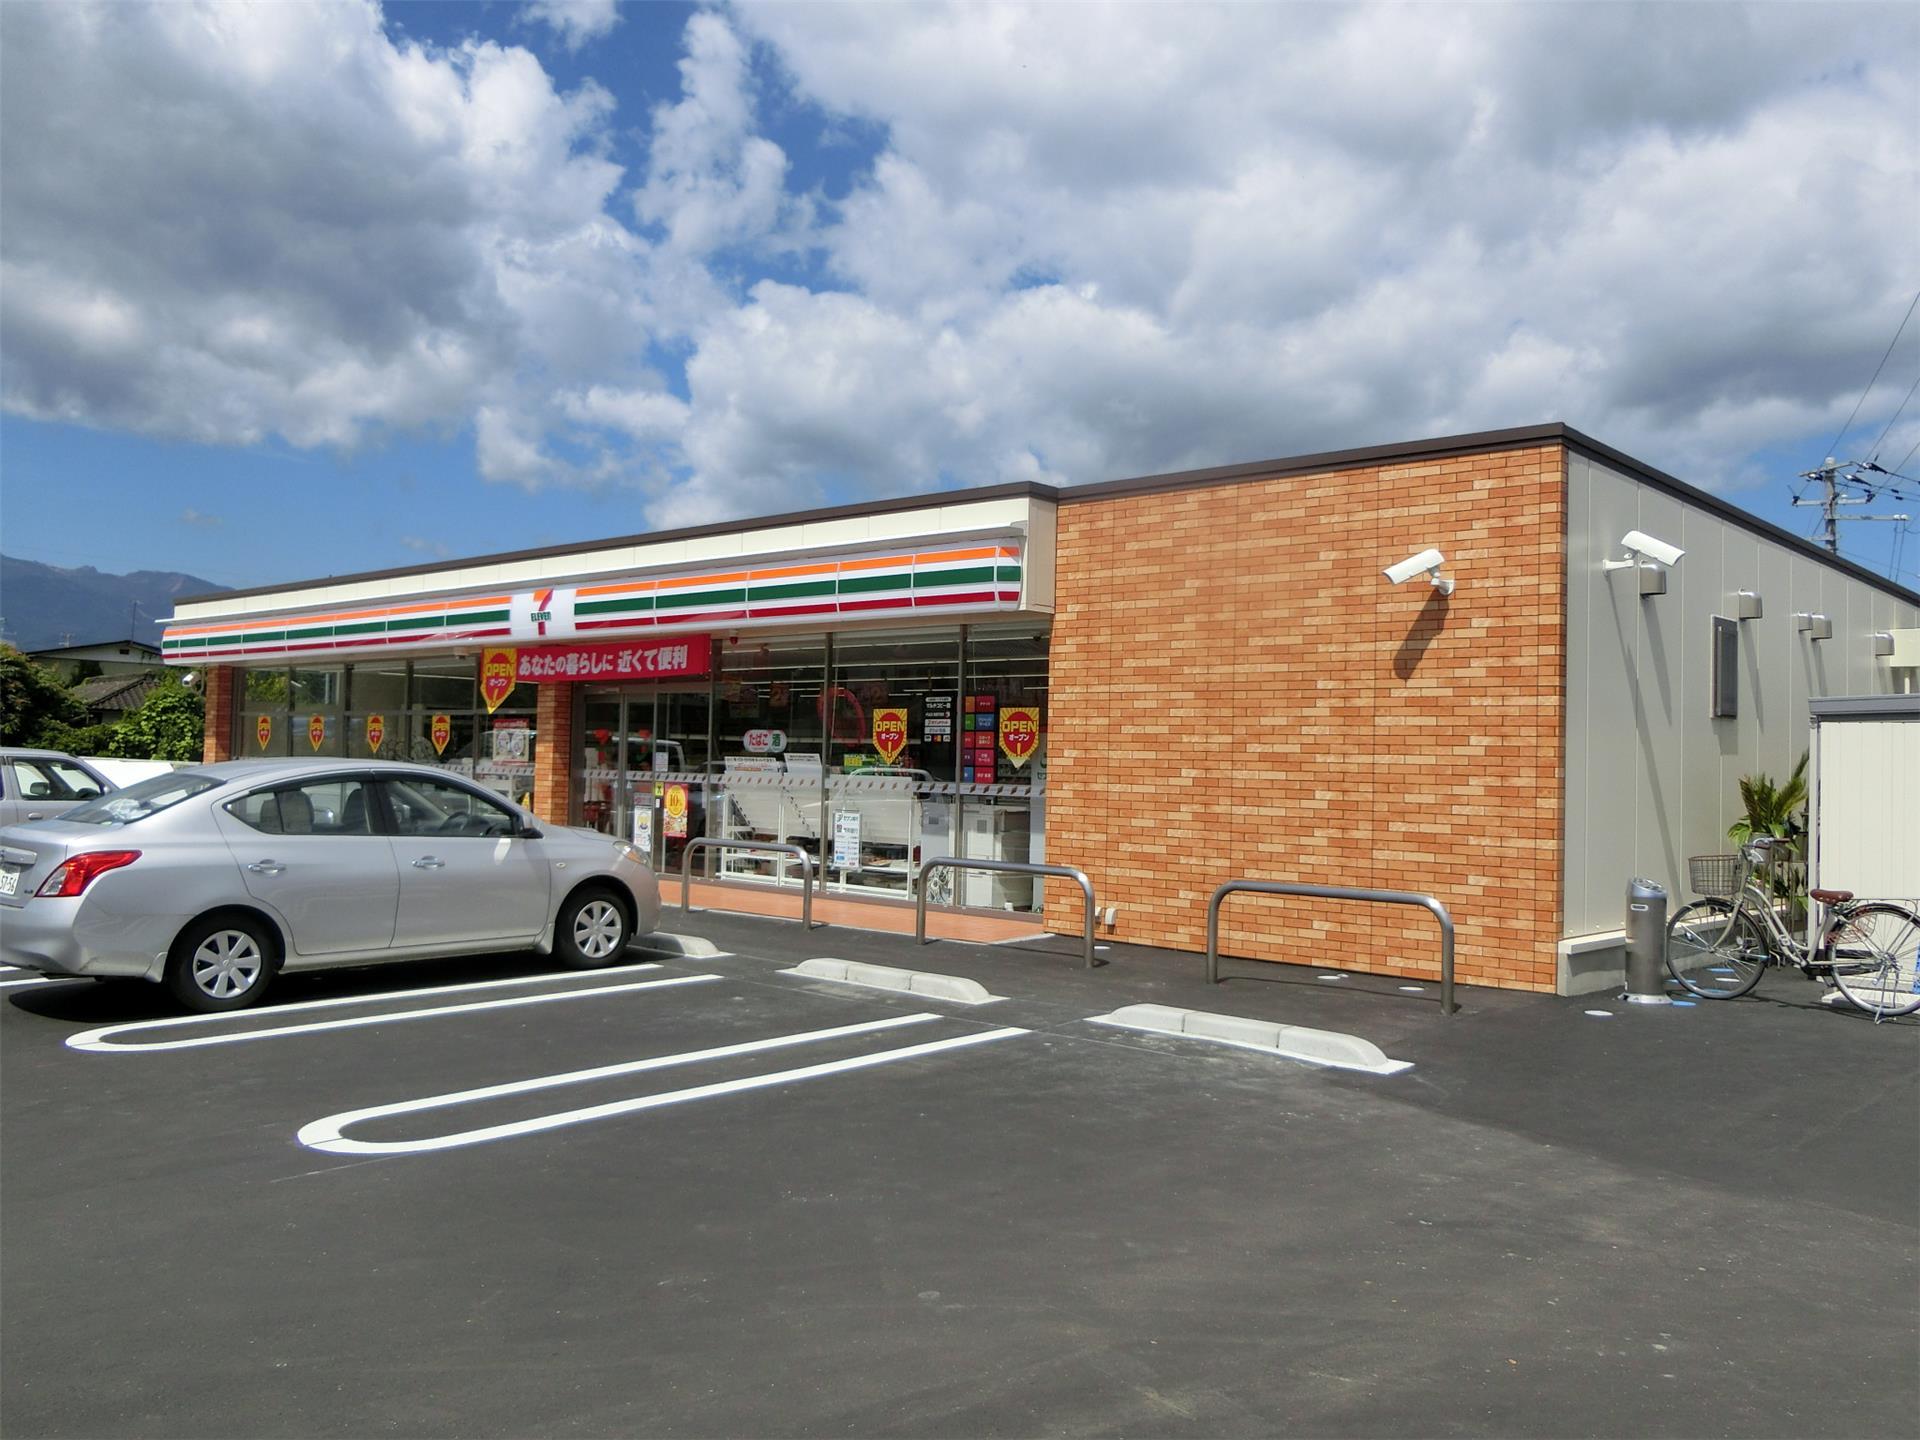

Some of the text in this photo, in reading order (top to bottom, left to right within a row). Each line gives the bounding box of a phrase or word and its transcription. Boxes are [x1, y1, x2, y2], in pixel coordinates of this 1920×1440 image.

[519, 645, 689, 676] あなたの暮らしに 近くて便利
[485, 663, 515, 676] OPEN
[875, 721, 905, 732] OPEN
[1001, 720, 1037, 732] OPEN
[748, 733, 782, 747] たばこ 酒
[1008, 733, 1030, 741] オープン
